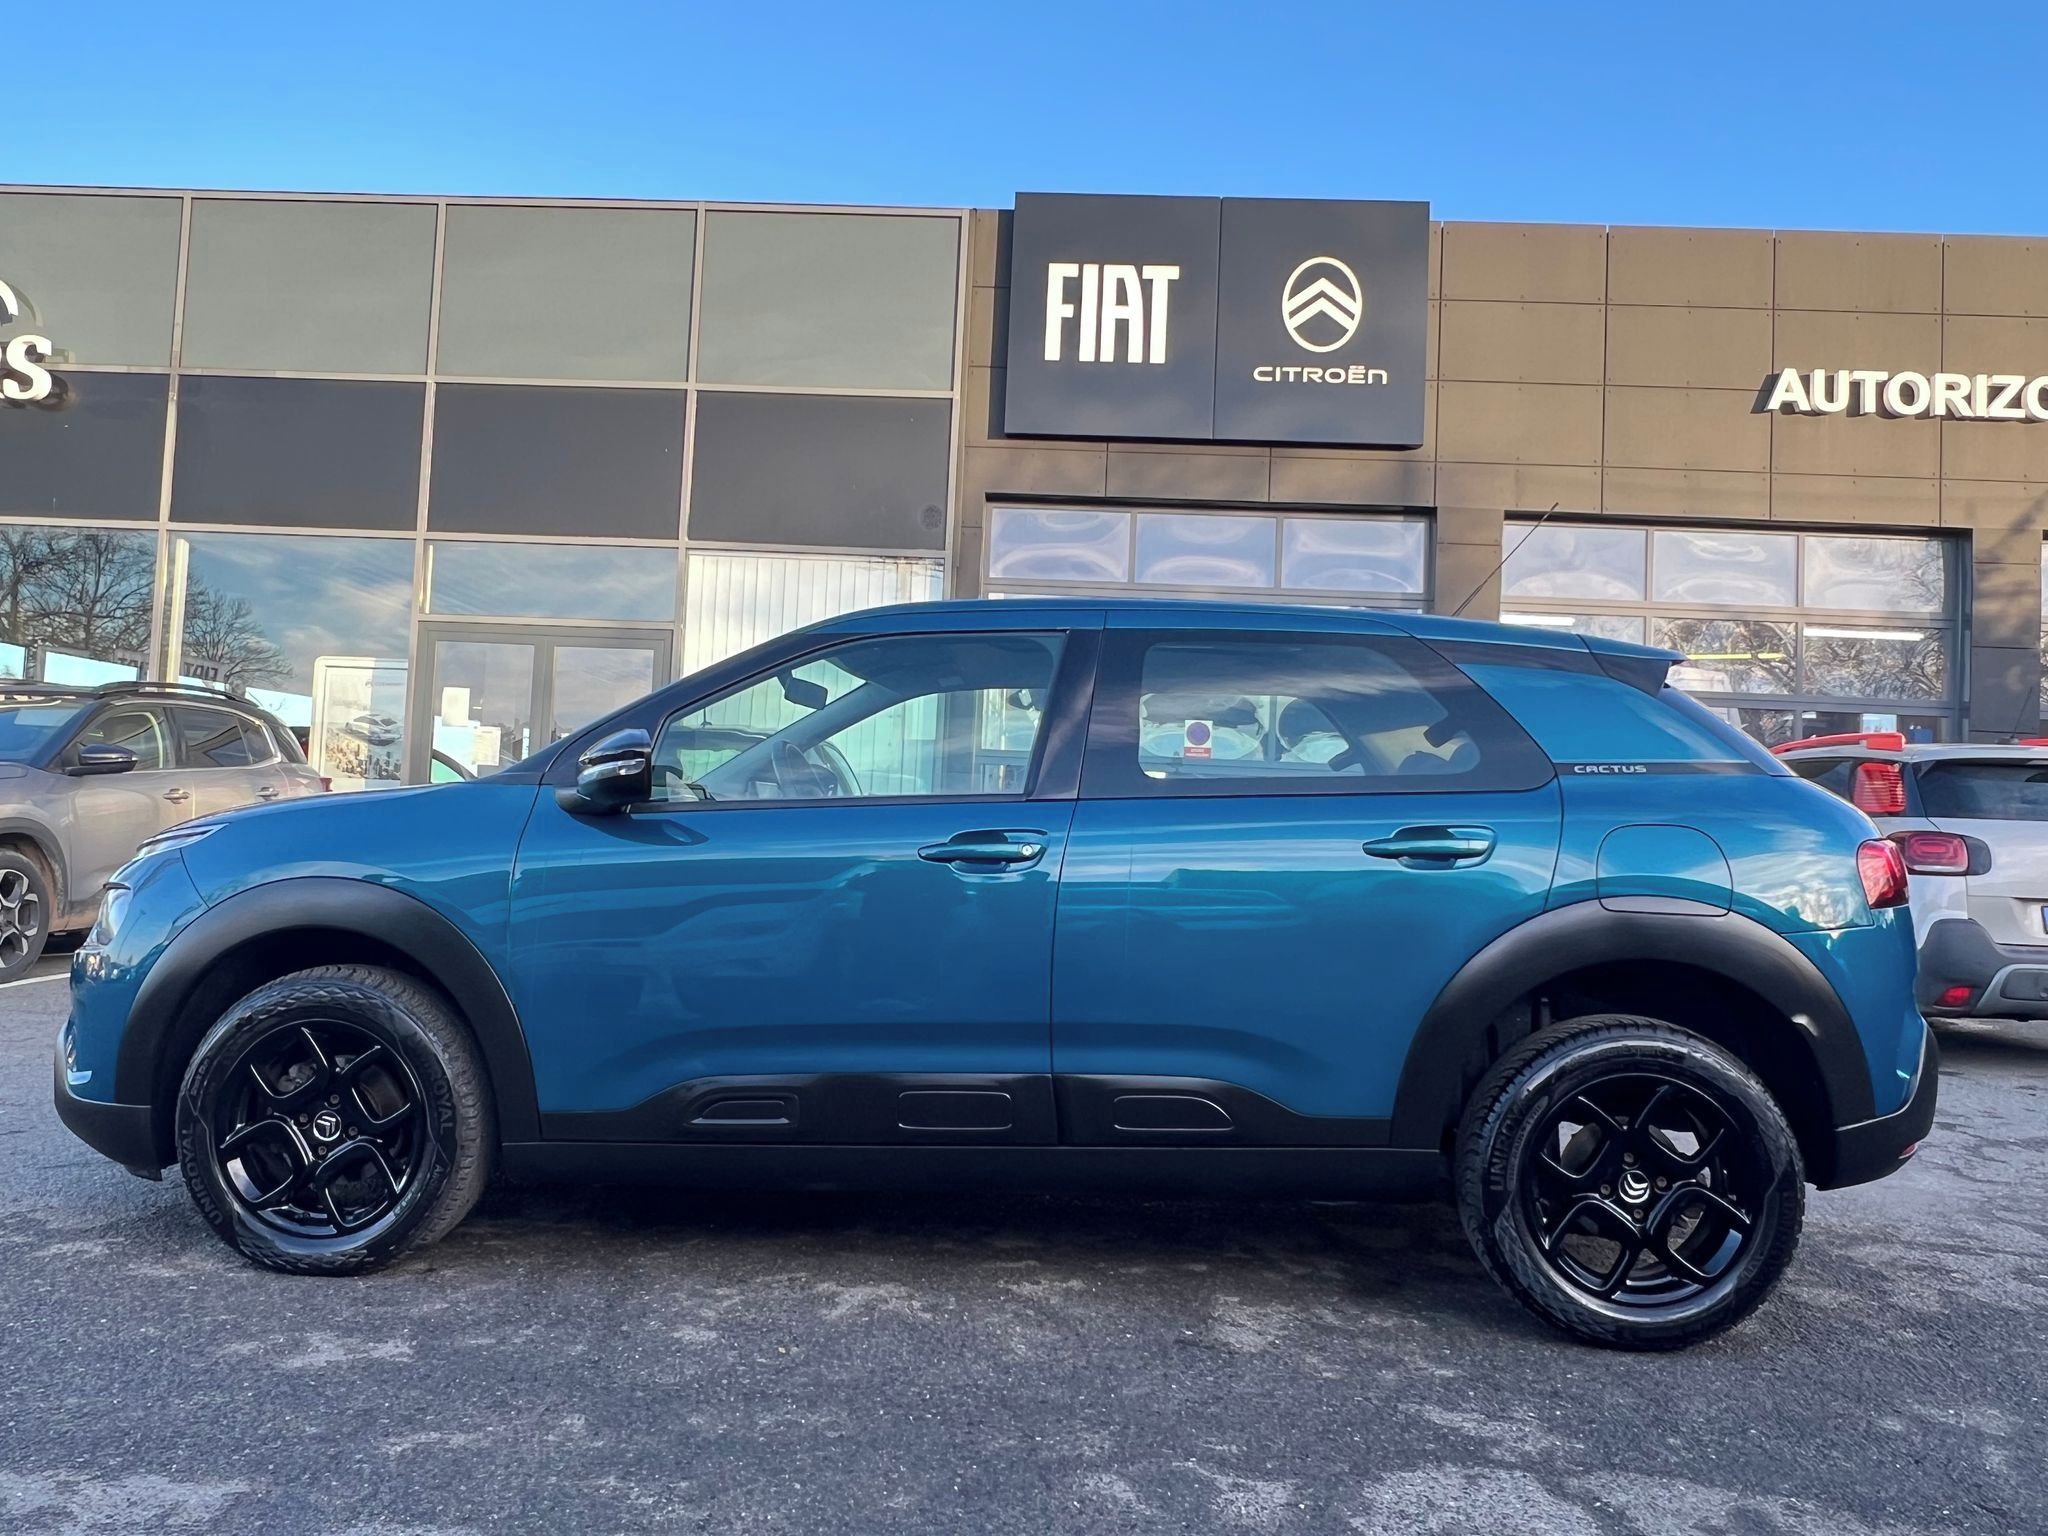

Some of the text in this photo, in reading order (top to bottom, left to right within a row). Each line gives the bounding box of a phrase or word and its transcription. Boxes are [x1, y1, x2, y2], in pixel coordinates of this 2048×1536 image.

[1044, 262, 1180, 364] FIAT
[1574, 764, 1647, 774] CACTUS
[181, 1122, 223, 1225] UNIROYAL
